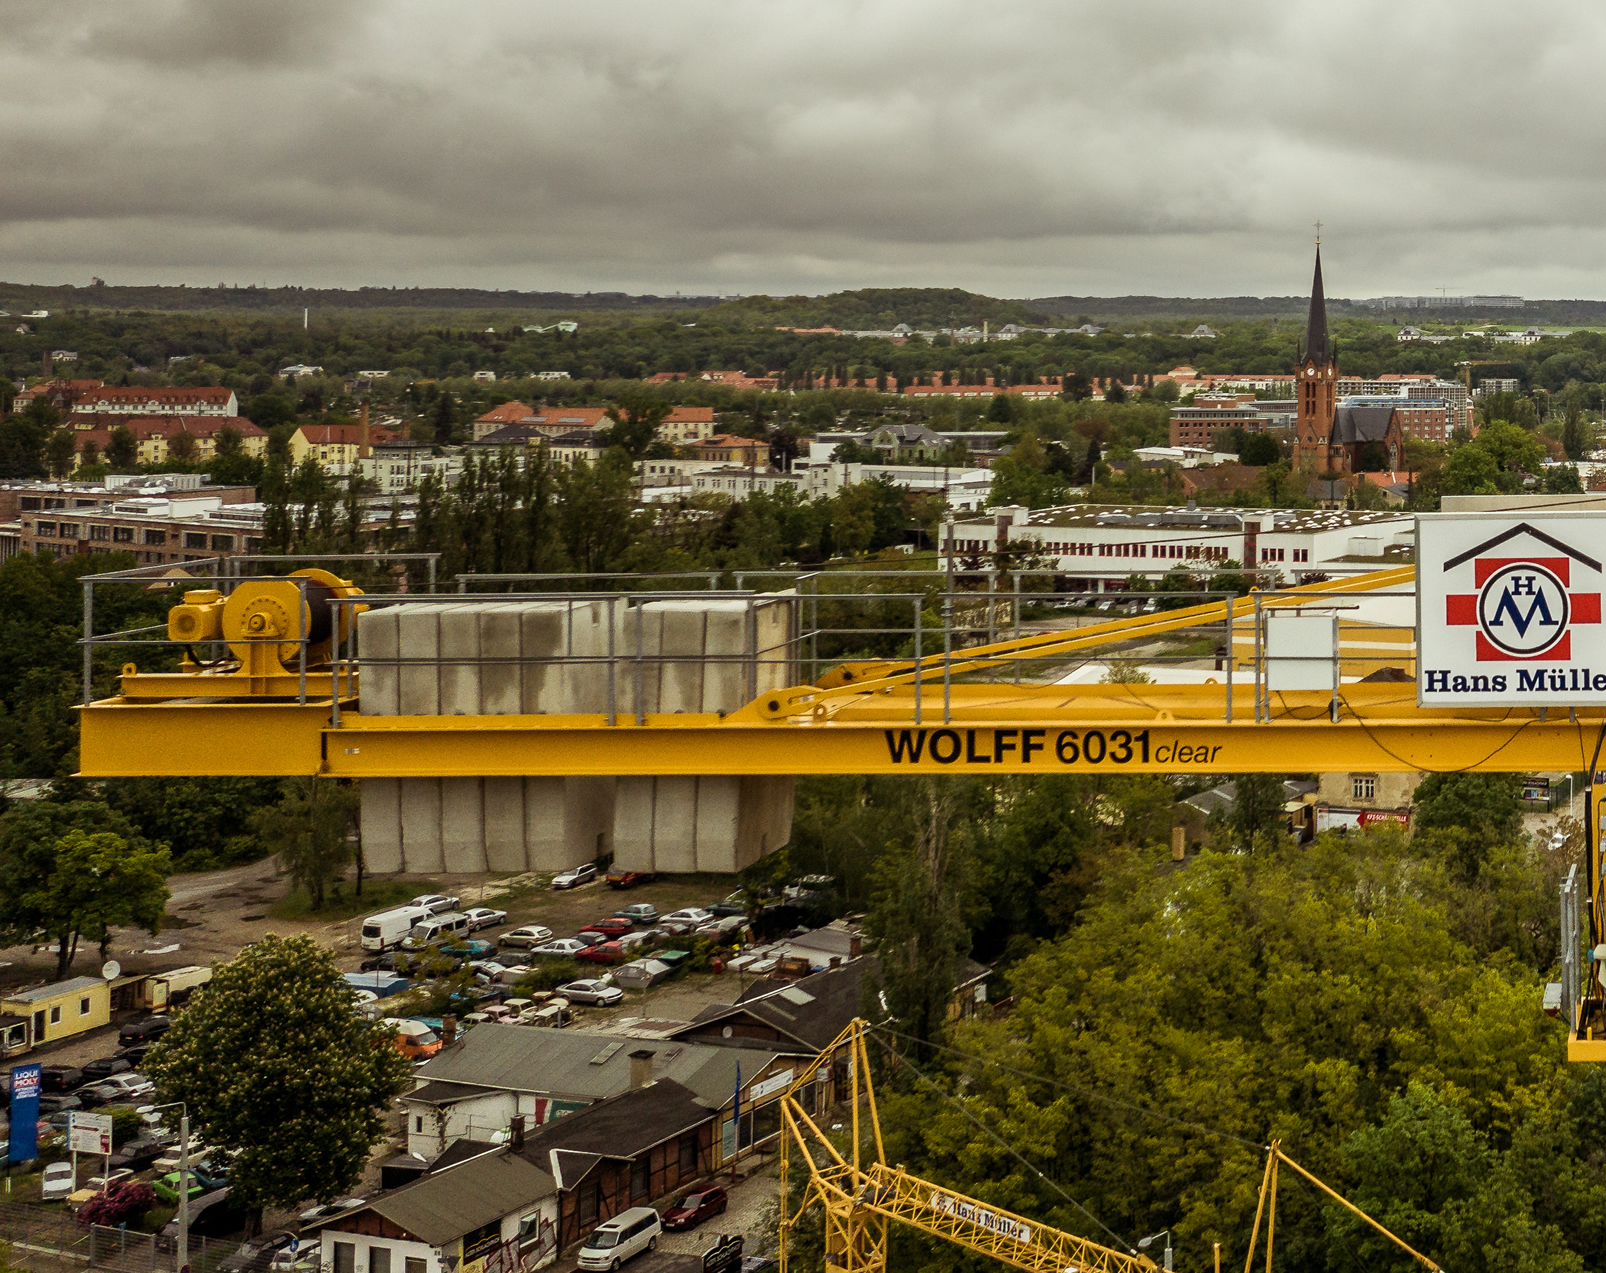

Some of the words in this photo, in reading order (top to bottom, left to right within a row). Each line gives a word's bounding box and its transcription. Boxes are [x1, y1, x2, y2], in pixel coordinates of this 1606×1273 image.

[1424, 669, 1507, 693] Hans
[884, 729, 1046, 764] WOLFF
[1055, 729, 1151, 764] 6031
[1154, 739, 1223, 764] clear
[15, 1070, 38, 1080] LIQUI
[15, 1077, 39, 1087] MOLY
